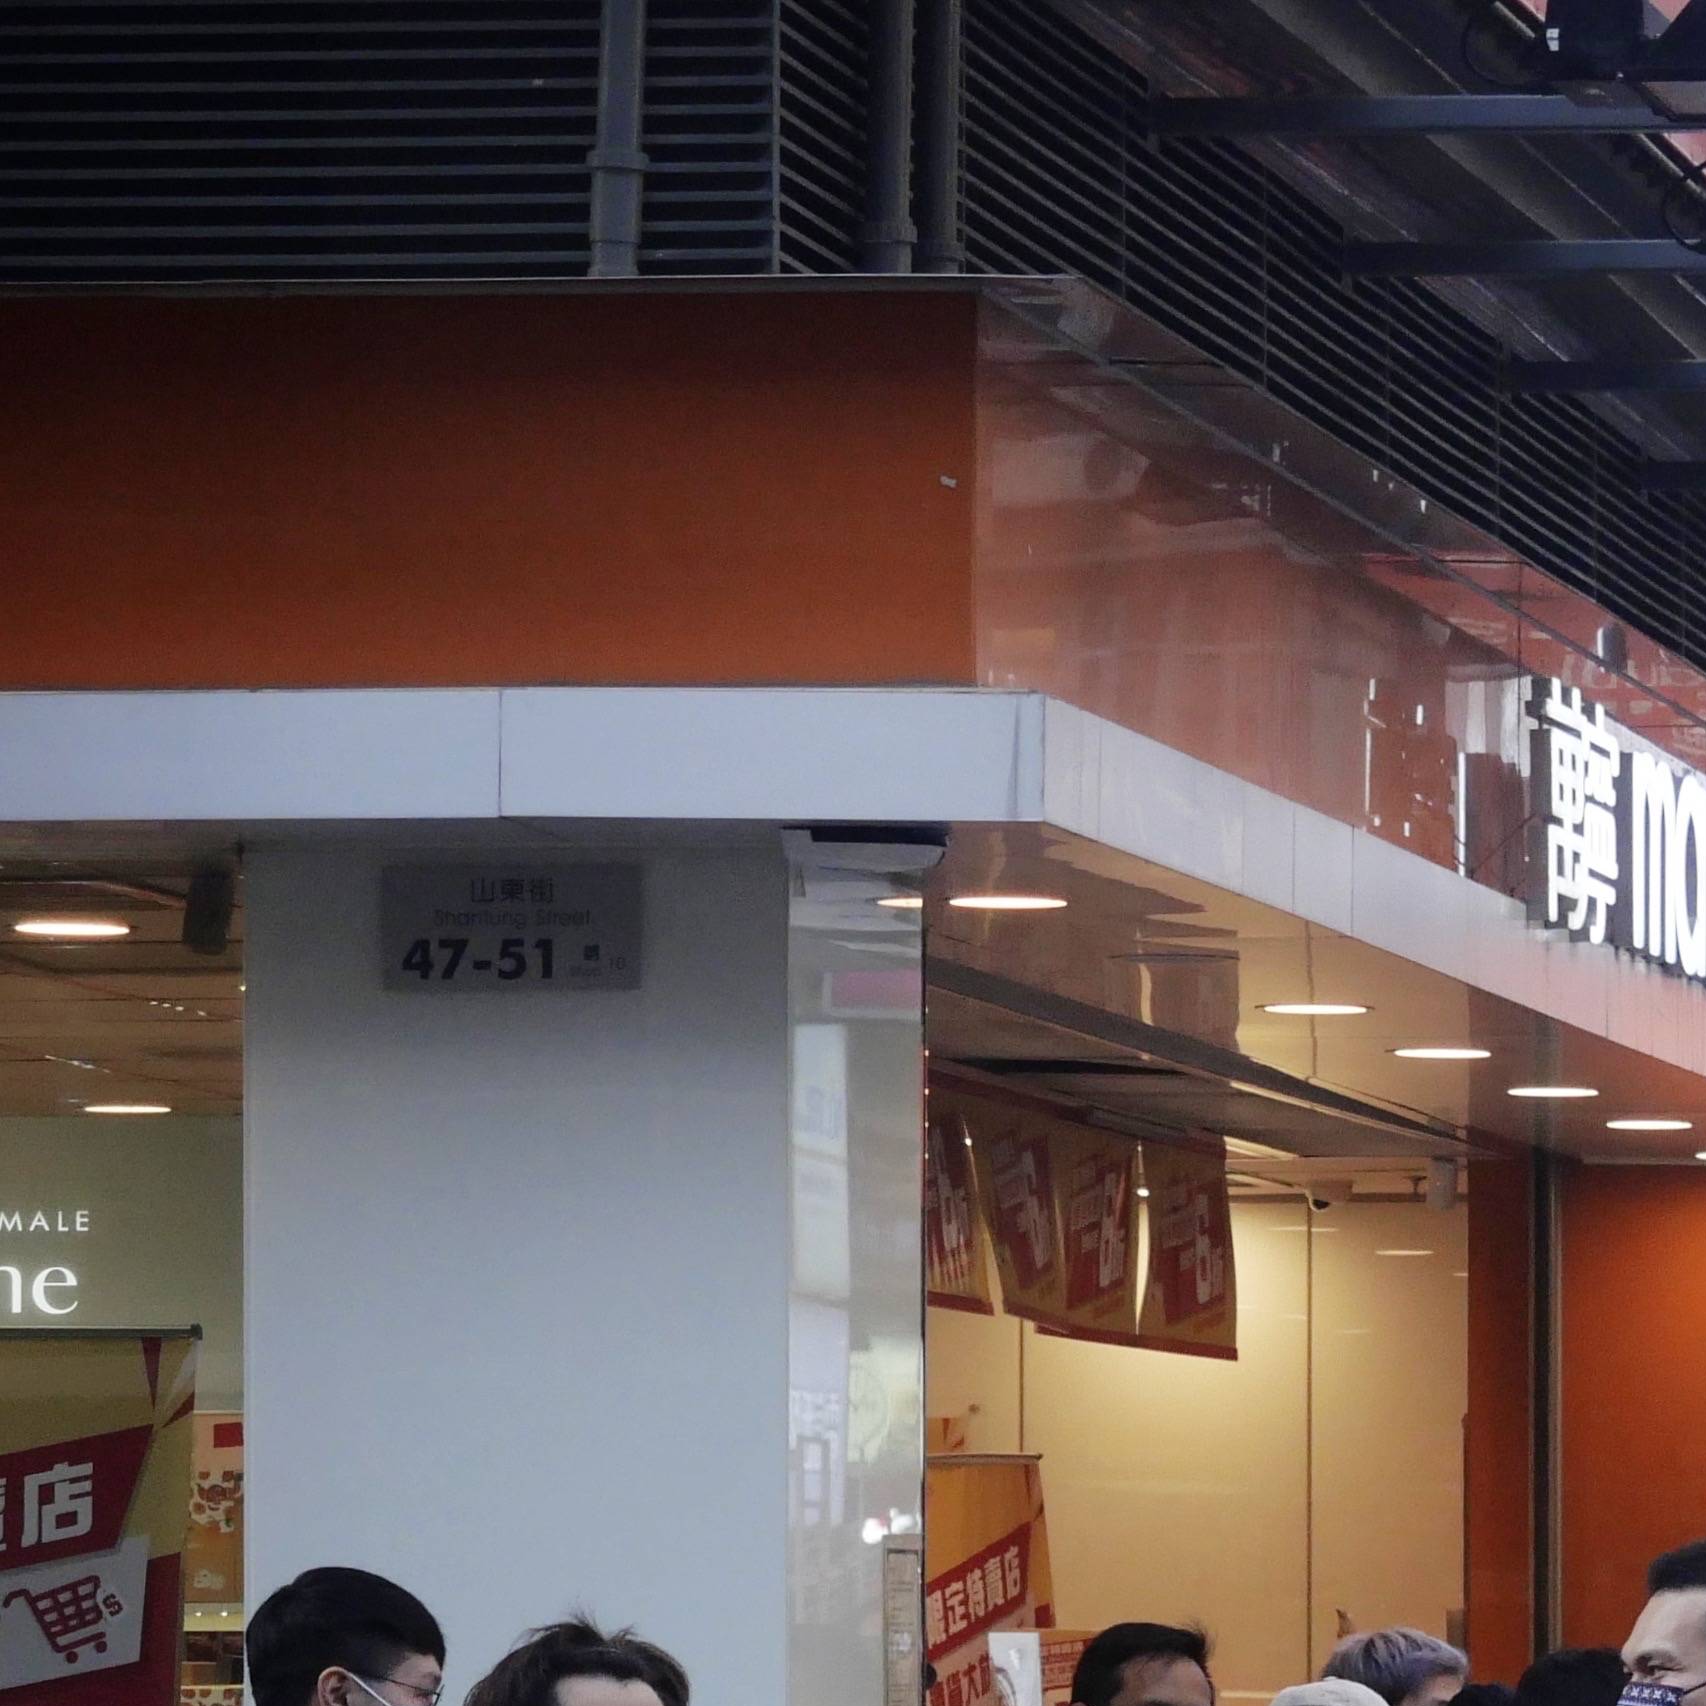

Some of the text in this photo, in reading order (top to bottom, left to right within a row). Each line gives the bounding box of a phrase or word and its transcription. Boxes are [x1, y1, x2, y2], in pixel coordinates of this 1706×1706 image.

[1546, 677, 1620, 944] 萬寧
[470, 878, 554, 903] 山東街
[432, 908, 593, 930] Shantung Street
[401, 937, 554, 980] 47-51
[0, 1460, 95, 1550] 店
